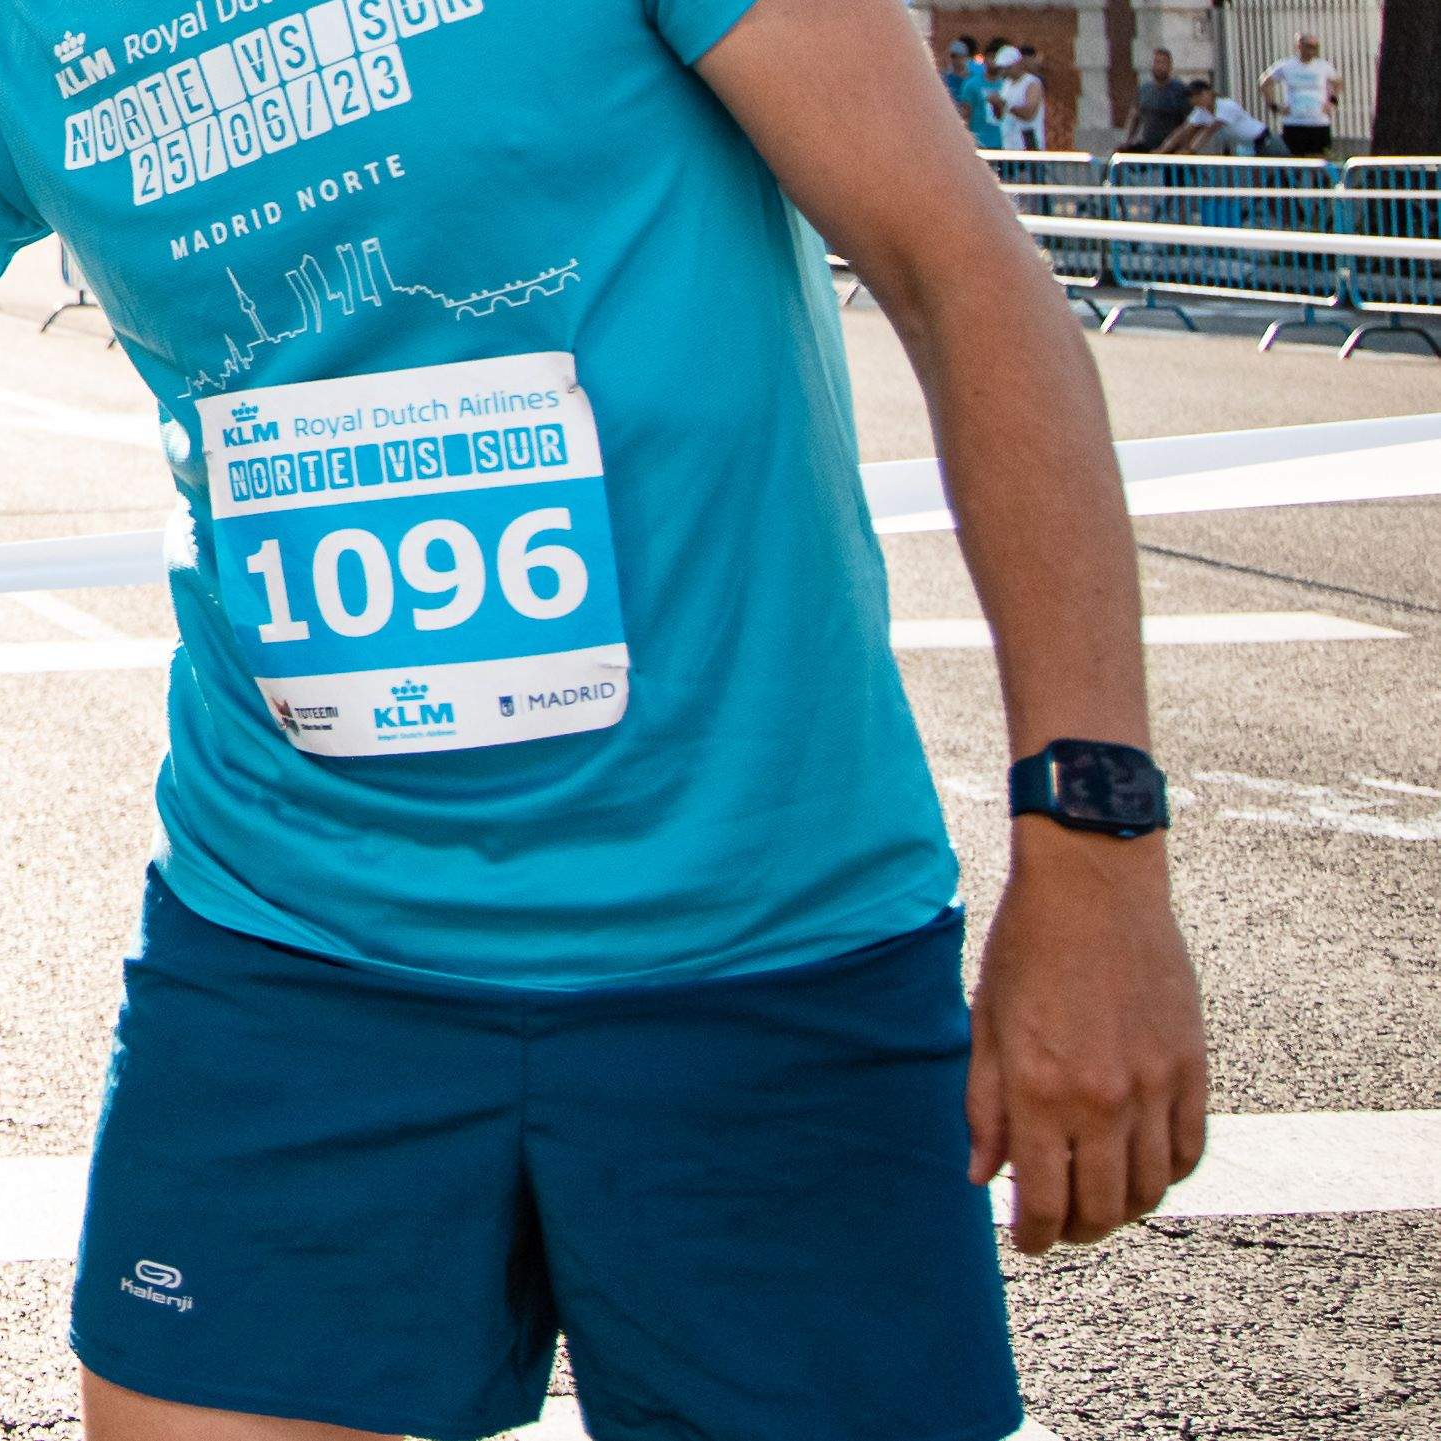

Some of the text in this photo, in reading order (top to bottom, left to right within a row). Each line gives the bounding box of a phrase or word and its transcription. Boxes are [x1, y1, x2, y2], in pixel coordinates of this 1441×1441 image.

[55, 47, 116, 99] KLM
[124, 0, 209, 62] Royal
[68, 61, 212, 166] NORTE
[237, 23, 307, 86] VS
[134, 50, 407, 202] 25/06/23
[171, 154, 406, 260] MADRID NORTE
[223, 388, 560, 449] KLM Royal Dutch Airlines
[229, 424, 566, 500] NORTE VS SUR
[246, 507, 589, 643] 1096
[373, 703, 455, 728] KLM
[528, 681, 616, 712] MADRID
[120, 1277, 193, 1312] Kalenji
